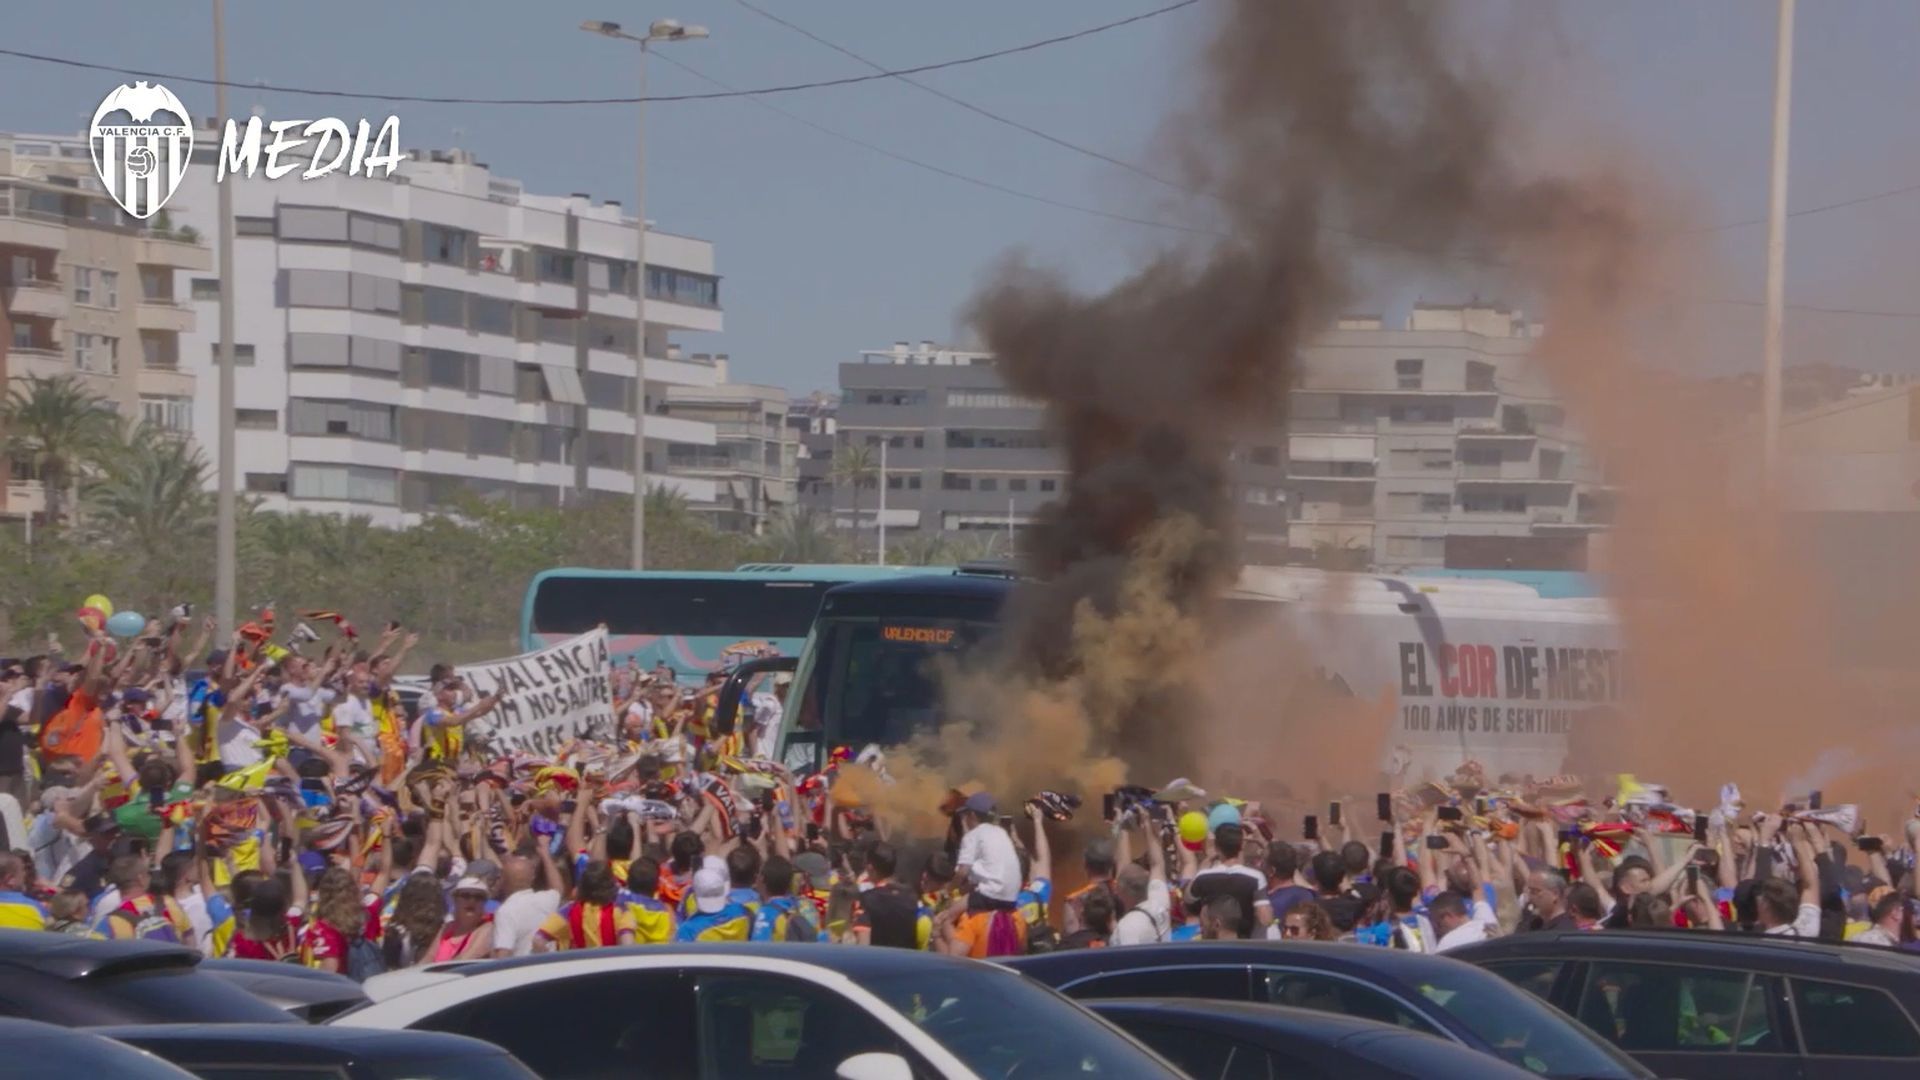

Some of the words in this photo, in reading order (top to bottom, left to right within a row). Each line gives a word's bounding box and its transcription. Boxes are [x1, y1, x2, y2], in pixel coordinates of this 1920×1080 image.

[486, 637, 608, 697] VALENCIA
[1399, 641, 1434, 697] EL
[1438, 643, 1499, 699] COR
[1502, 645, 1541, 700] DE
[1544, 647, 1620, 702] MEST
[1403, 704, 1431, 731] 100
[1435, 705, 1477, 732] ANYS
[1481, 706, 1501, 733] DE
[1506, 707, 1572, 734] SENTIME
